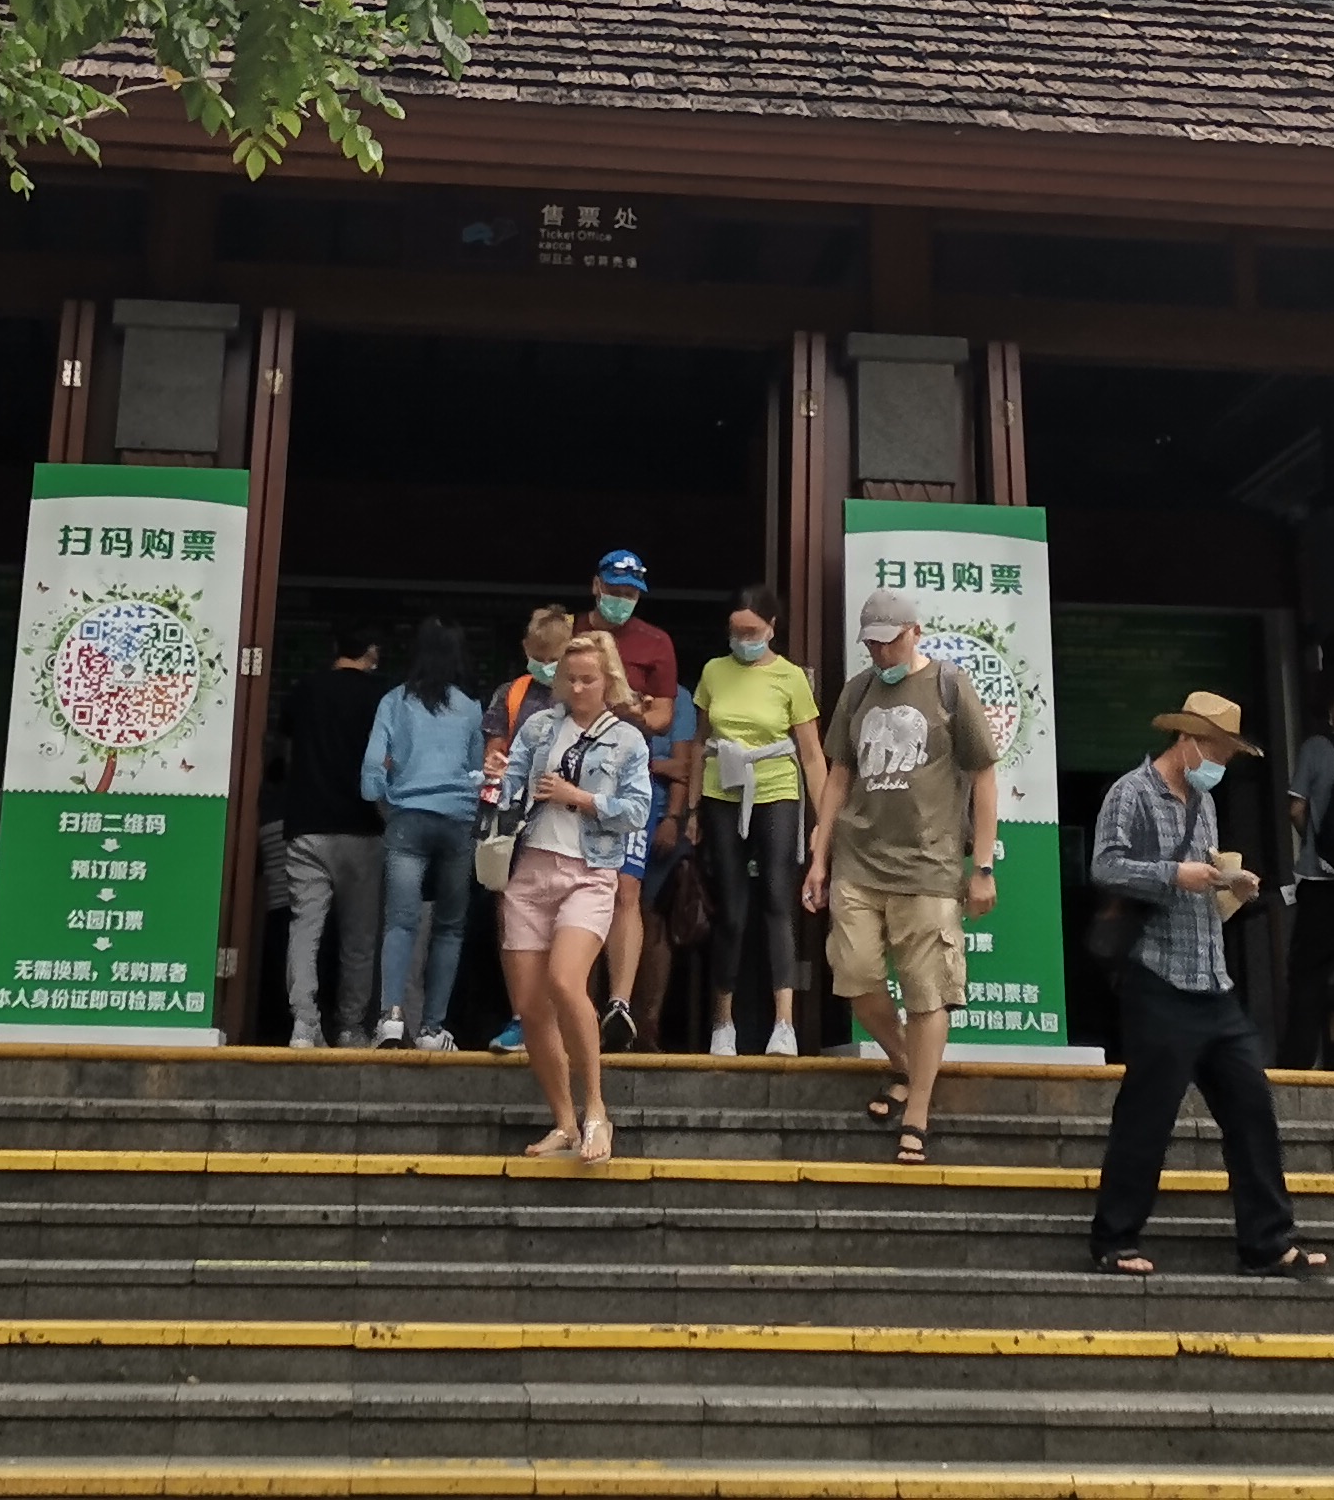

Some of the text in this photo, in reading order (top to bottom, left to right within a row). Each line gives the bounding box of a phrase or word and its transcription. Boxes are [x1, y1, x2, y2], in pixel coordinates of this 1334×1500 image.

[541, 204, 638, 230] 售票处
[539, 228, 612, 242] Ticket Office
[57, 524, 217, 563] 扫码购票
[874, 558, 1023, 596] 扫码购票
[58, 811, 166, 835] 扫描二维码
[69, 859, 147, 881] 预订服务
[67, 909, 144, 931] 公园门票
[964, 932, 994, 953] 门票
